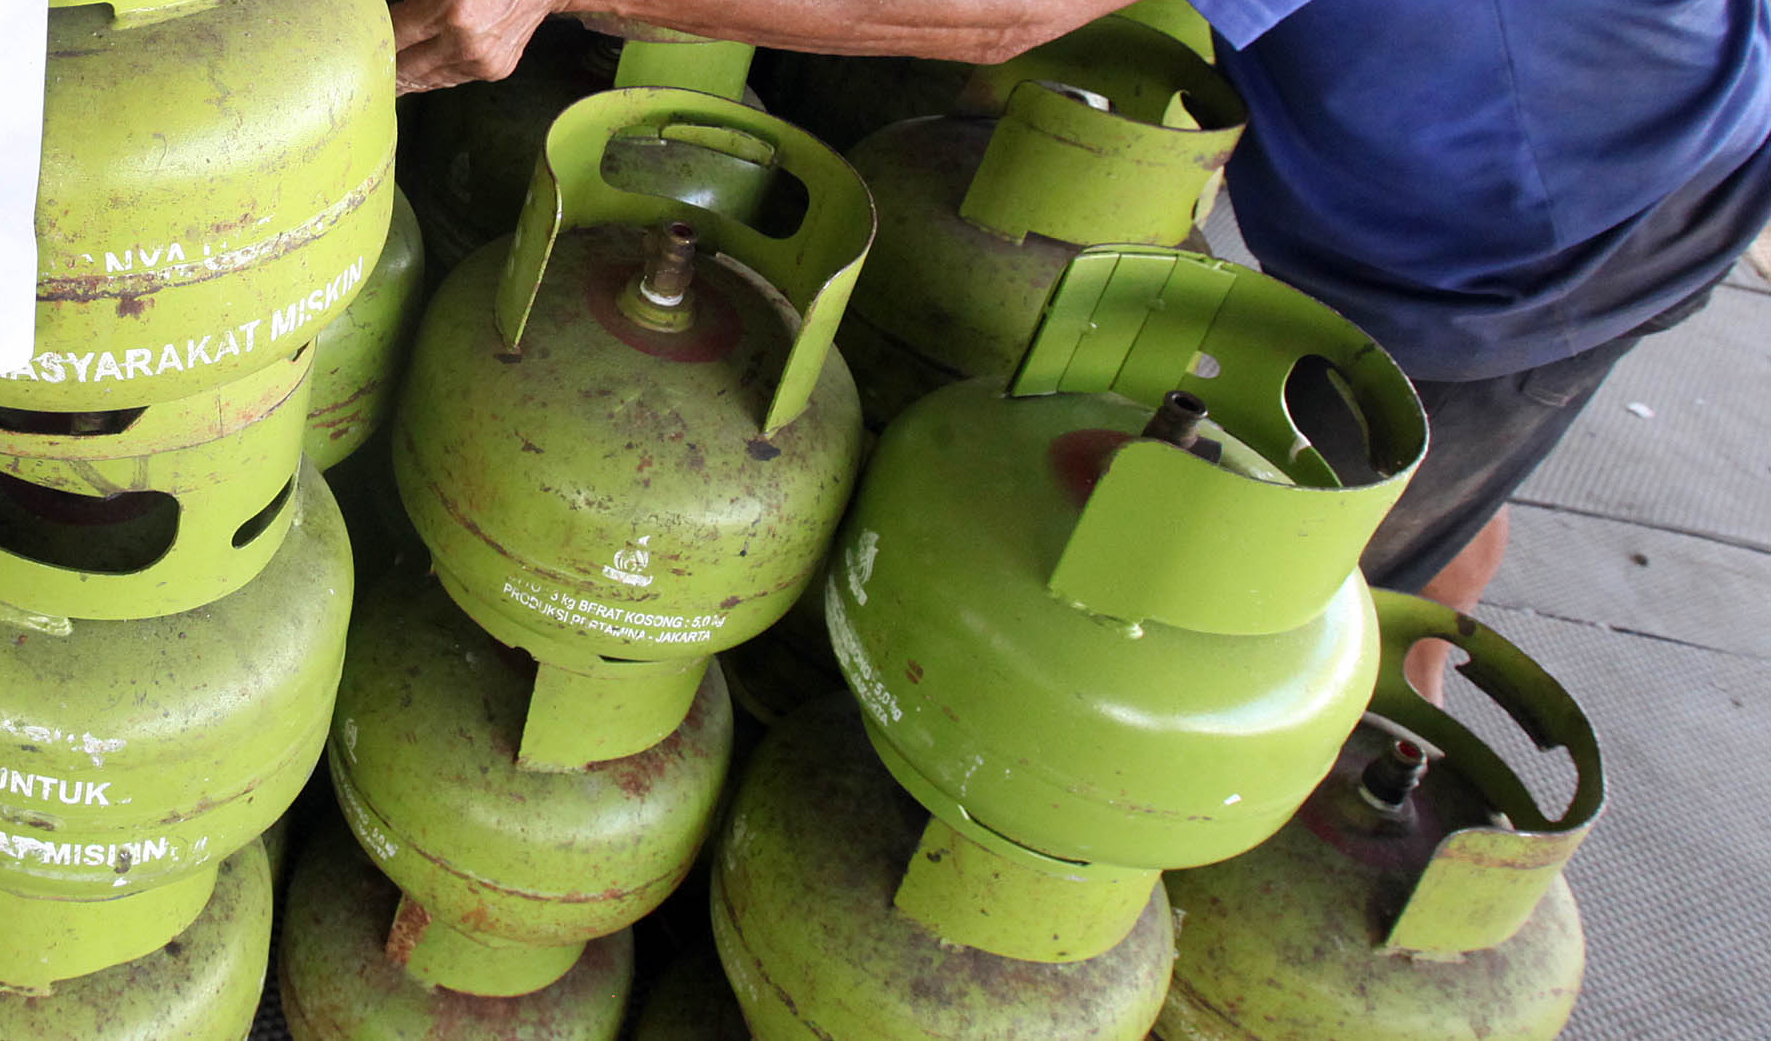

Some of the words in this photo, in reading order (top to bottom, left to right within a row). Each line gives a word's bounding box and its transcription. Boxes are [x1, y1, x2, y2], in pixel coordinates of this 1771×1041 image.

[1, 319, 261, 382] ASYARAKAT
[270, 256, 363, 342] MISKIN
[503, 582, 569, 623] PRODUKSI
[655, 630, 712, 644] JAKARTA
[550, 588, 559, 602] 3
[560, 593, 576, 610] kg
[578, 599, 624, 621] BERAT
[624, 609, 685, 629] KOSONG
